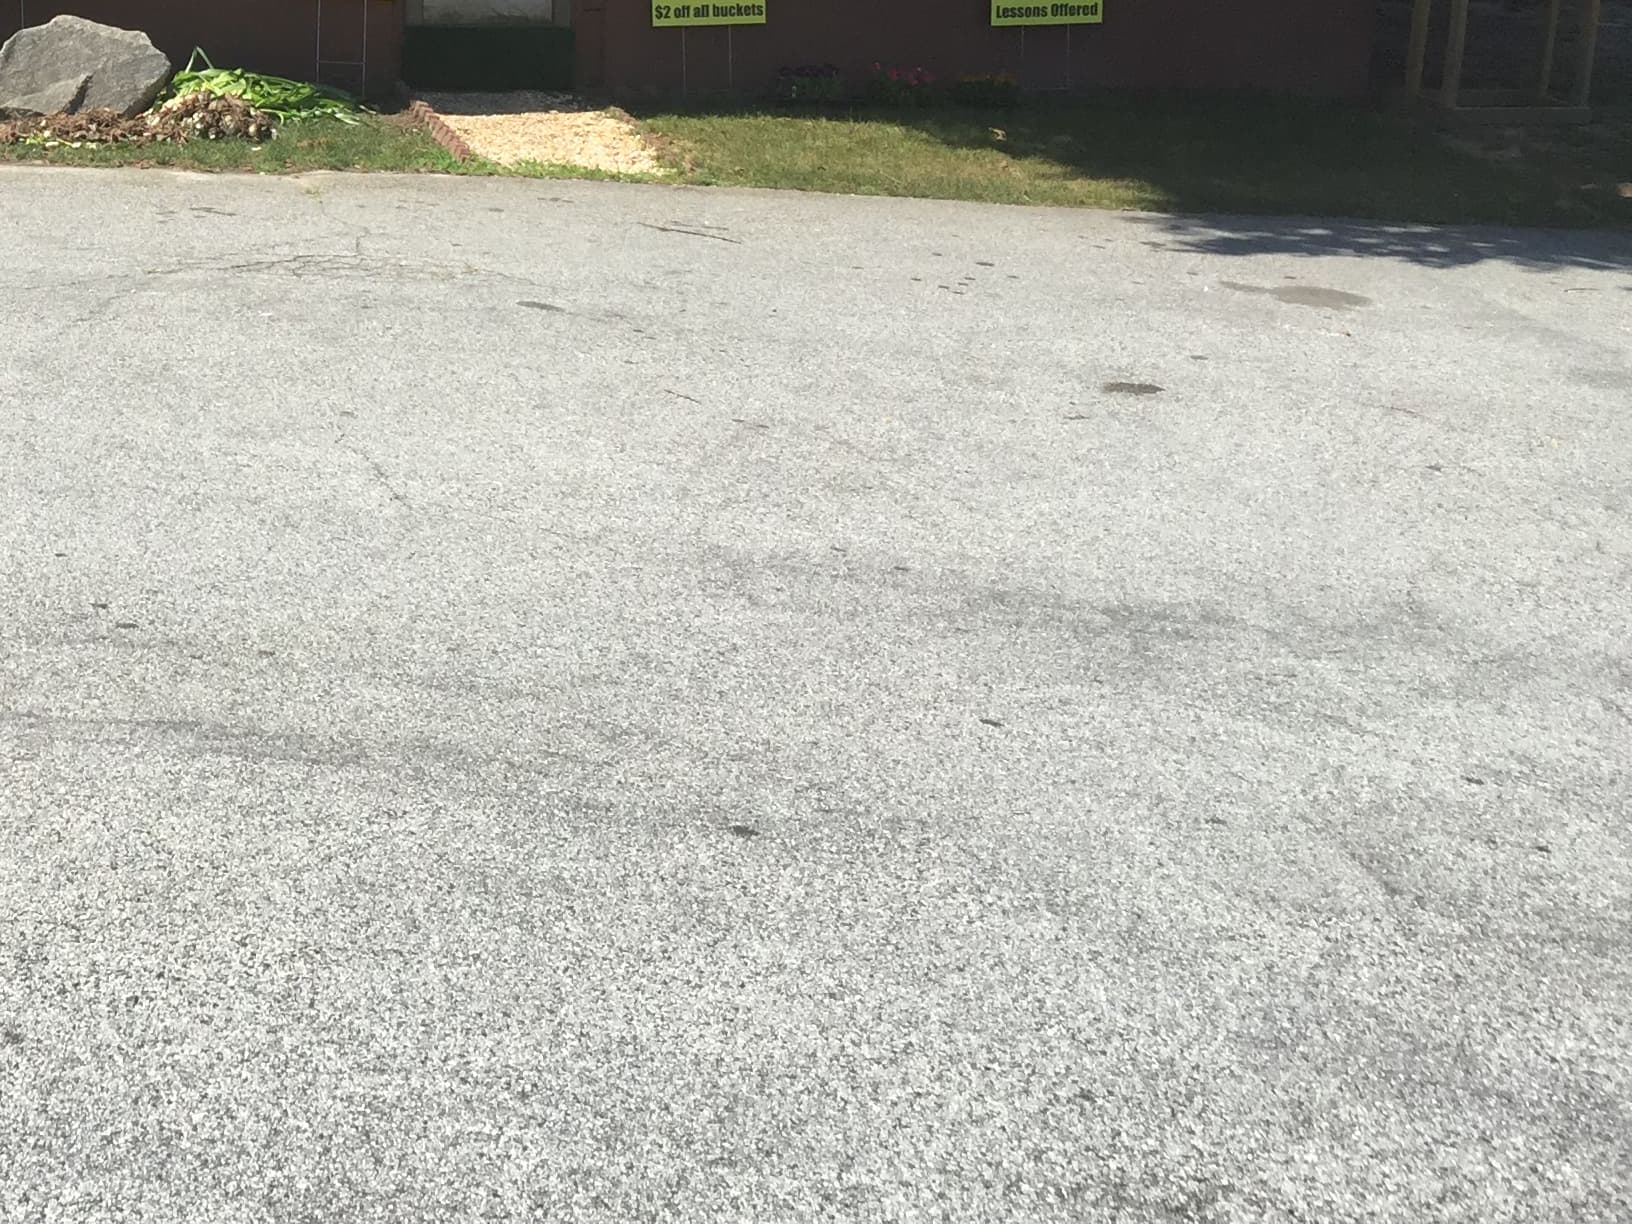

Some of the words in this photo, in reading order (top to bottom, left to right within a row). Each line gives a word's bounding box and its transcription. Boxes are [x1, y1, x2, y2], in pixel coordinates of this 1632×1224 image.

[654, 4, 672, 20] $2
[673, 4, 691, 19] off
[693, 4, 710, 19] all
[712, 2, 764, 18] buckets
[995, 5, 1048, 19] Lessons
[1050, 2, 1099, 18] Offered
